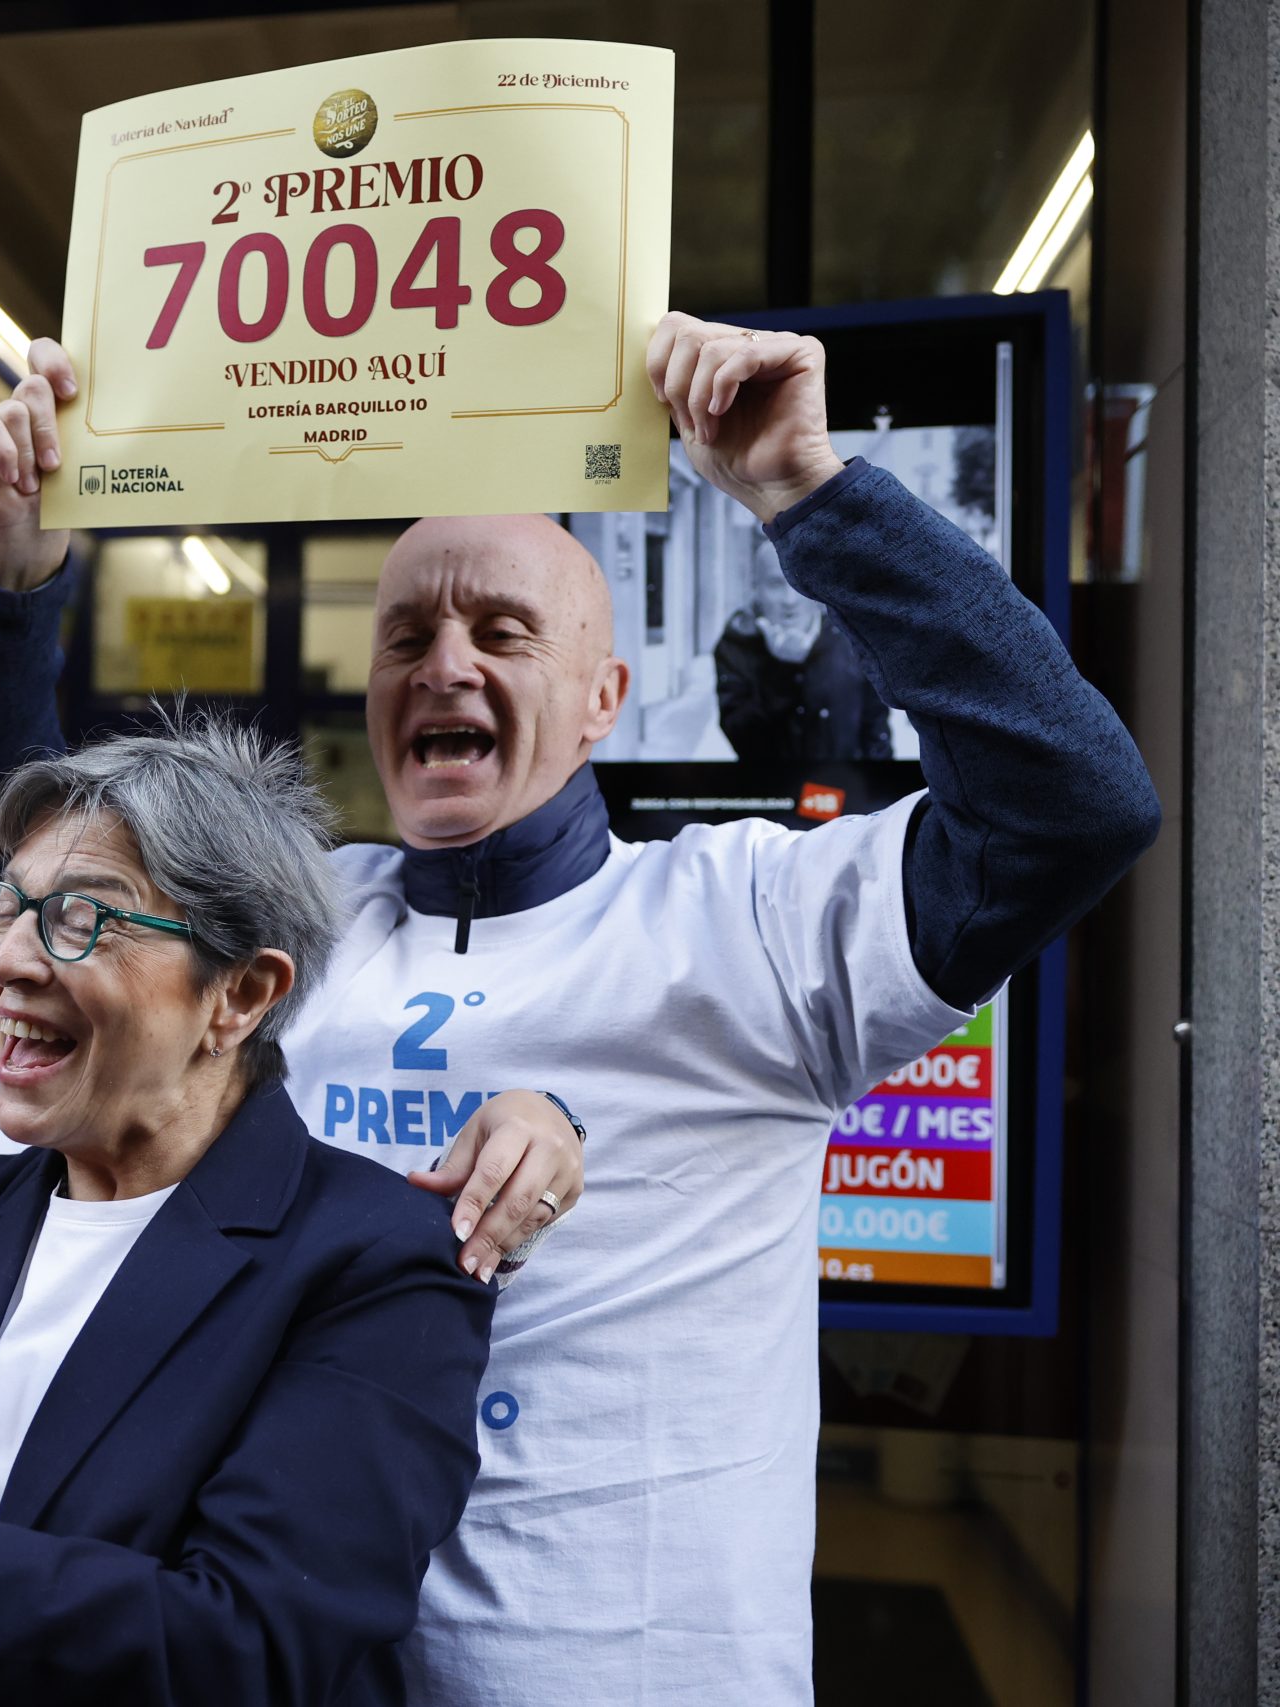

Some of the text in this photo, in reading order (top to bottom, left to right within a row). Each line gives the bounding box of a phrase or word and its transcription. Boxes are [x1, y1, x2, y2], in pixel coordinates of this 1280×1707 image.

[497, 73, 630, 91] 22 de Diciembre
[157, 122, 173, 135] de
[175, 107, 234, 132] Navidad
[325, 131, 344, 147] NOS
[345, 119, 366, 137] UNE
[263, 153, 484, 218] PREMIO
[143, 208, 567, 350] 70048
[224, 345, 447, 388] VENDIDO AQUÍ
[248, 398, 428, 419] LOTERÍA BARQUILLO 10
[303, 428, 367, 443] MADRID
[111, 465, 169, 481] LOTERÍA
[111, 480, 185, 494] NACIONAL
[323, 1083, 504, 1147] PREM
[890, 1105, 911, 1138] /
[916, 1106, 993, 1142] MES
[825, 1149, 945, 1191] JUGÓN
